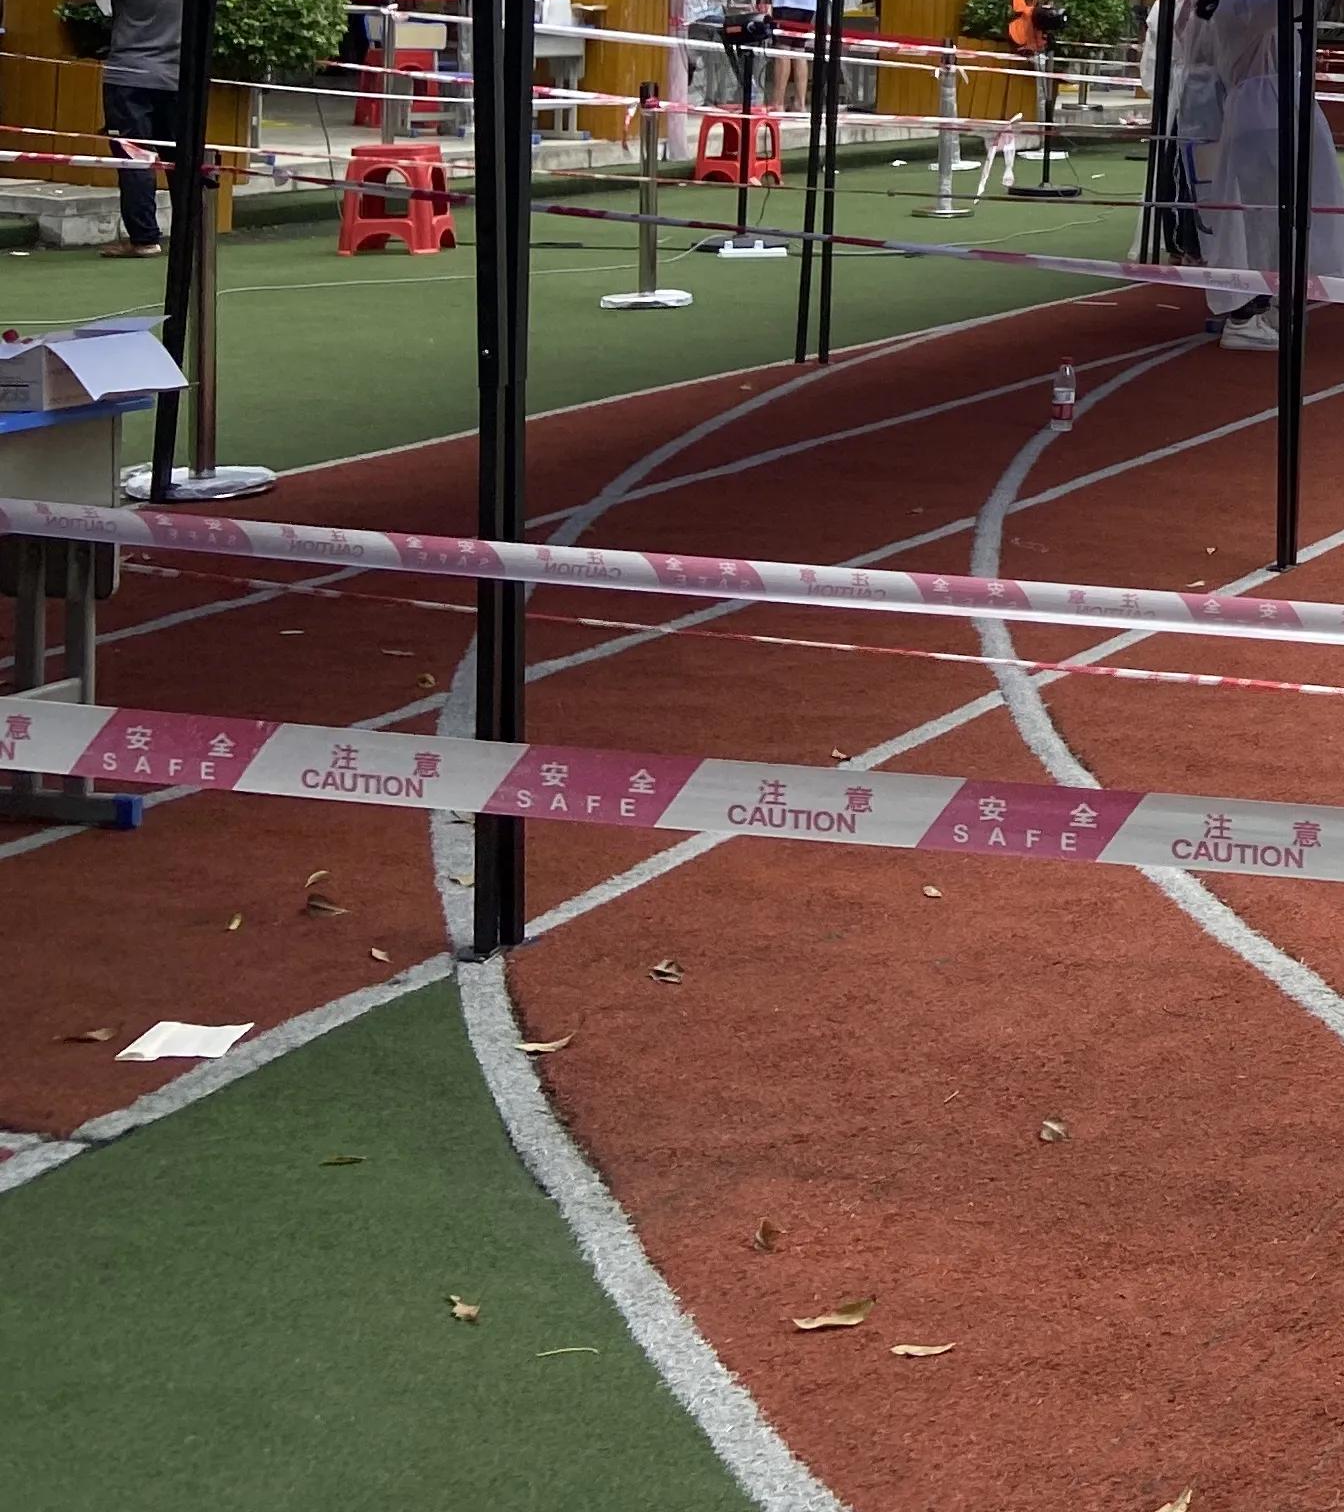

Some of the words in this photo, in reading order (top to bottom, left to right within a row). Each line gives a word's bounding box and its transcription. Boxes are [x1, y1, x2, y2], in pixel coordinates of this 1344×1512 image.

[126, 725, 235, 758] 安全
[103, 751, 216, 781] SAFE
[331, 744, 441, 778] 注意
[301, 768, 424, 798] CAUTION
[539, 762, 656, 795] 安全
[517, 790, 636, 817] SAFE
[759, 778, 872, 813] 注意
[727, 804, 856, 834] CAUTION
[978, 796, 1098, 829] 安全
[953, 825, 1077, 852] SAFE
[1203, 814, 1322, 848] 注意
[1171, 838, 1304, 869] CAUTION
